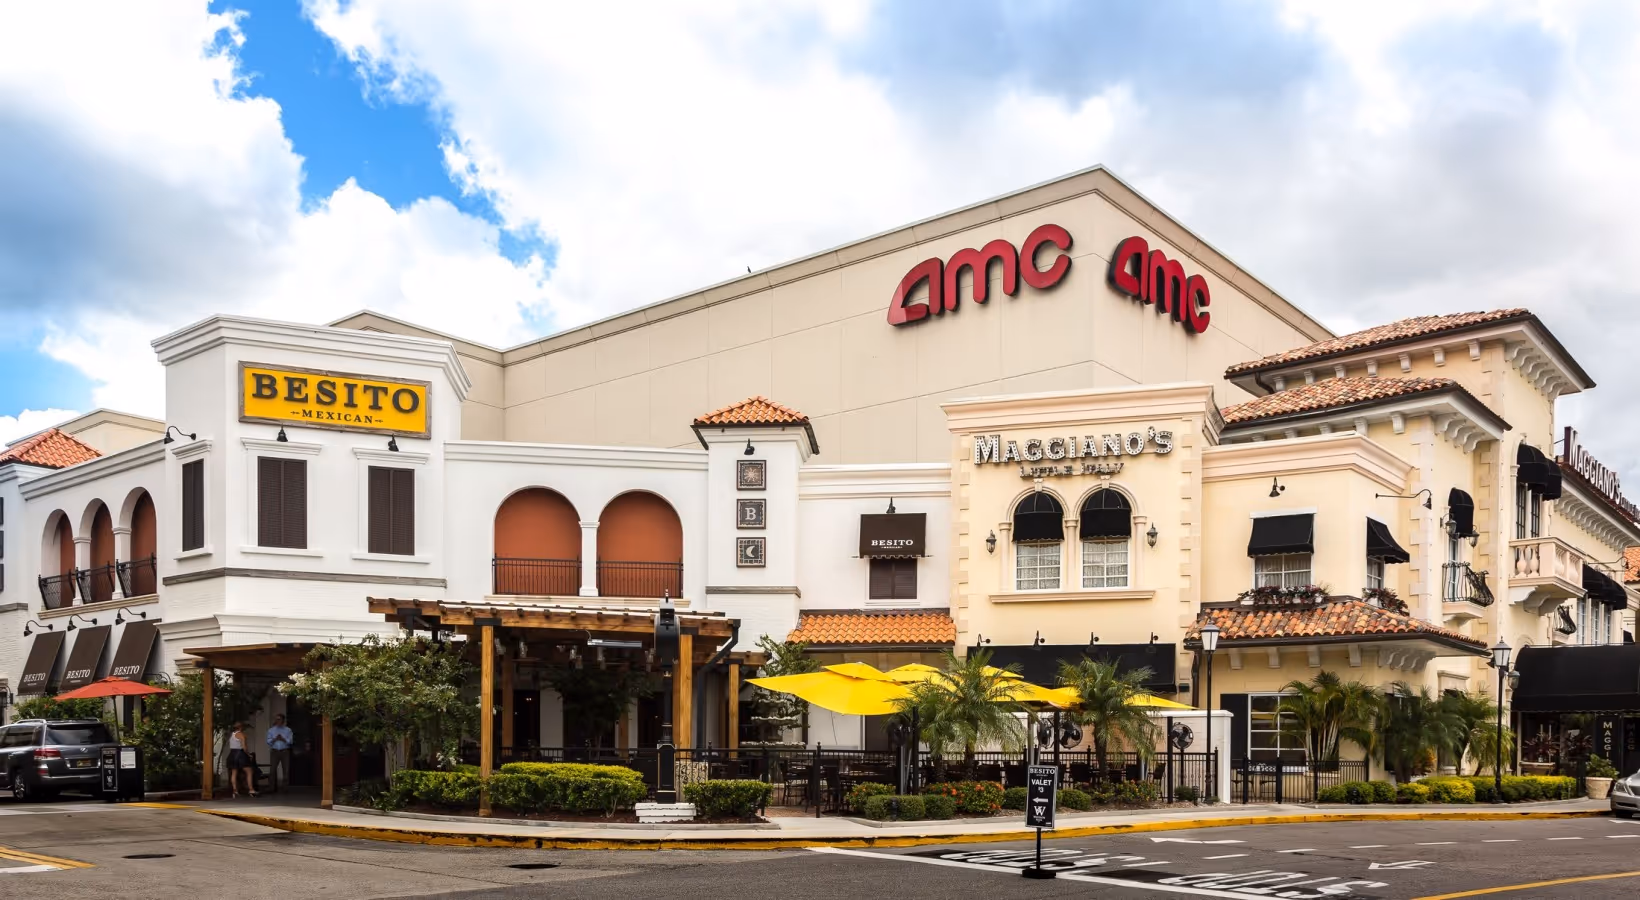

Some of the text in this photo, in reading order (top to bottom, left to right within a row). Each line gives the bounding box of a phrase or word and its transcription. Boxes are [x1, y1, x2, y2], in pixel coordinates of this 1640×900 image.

[251, 373, 420, 414] BESITO
[301, 408, 374, 424] MEXICAN
[974, 425, 1174, 465] MAGGIANO'S
[744, 507, 757, 521] B
[23, 673, 46, 682] BESITO
[66, 669, 91, 679] BESITO
[113, 666, 141, 676] BESITO
